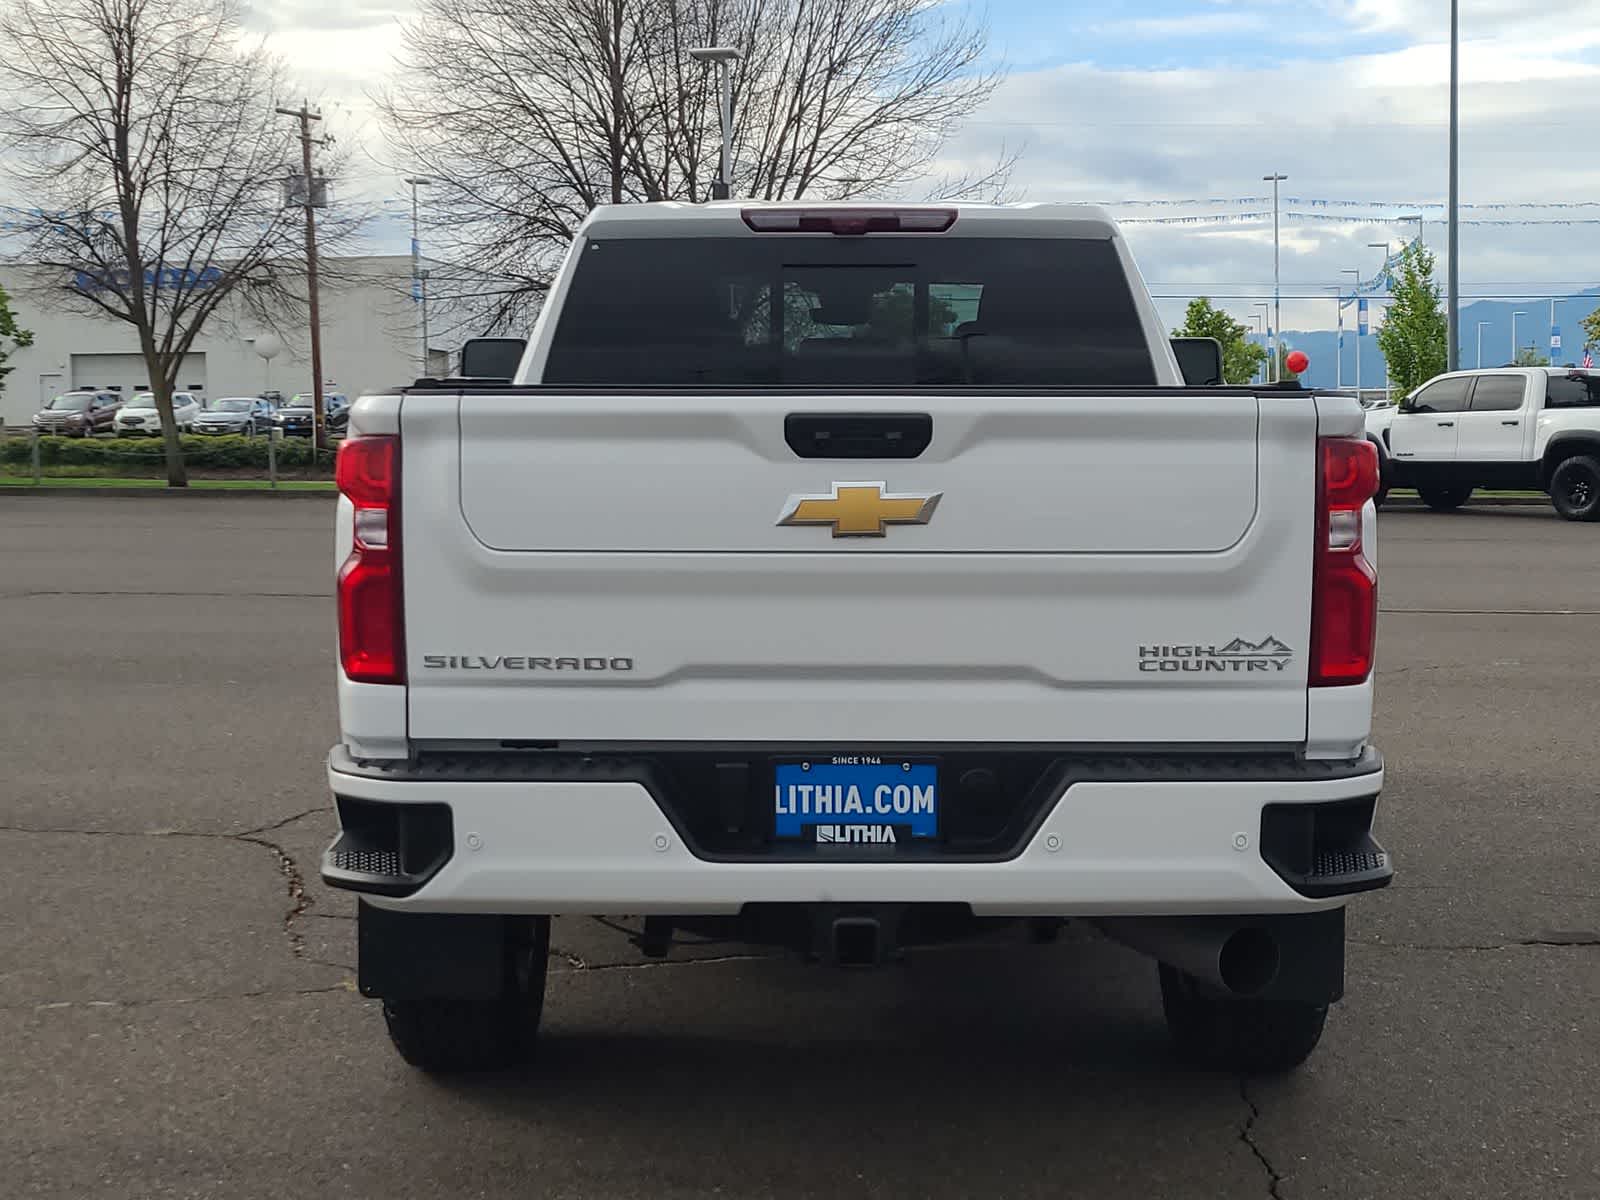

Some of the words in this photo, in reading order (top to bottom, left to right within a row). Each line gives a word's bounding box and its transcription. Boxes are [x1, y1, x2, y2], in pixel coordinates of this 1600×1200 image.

[1139, 645, 1216, 657] HIGH
[424, 655, 633, 670] SILVERADO
[1139, 659, 1292, 672] COUNTRY
[775, 785, 934, 814] LITHIA.COM
[834, 825, 896, 842] LITHIA
